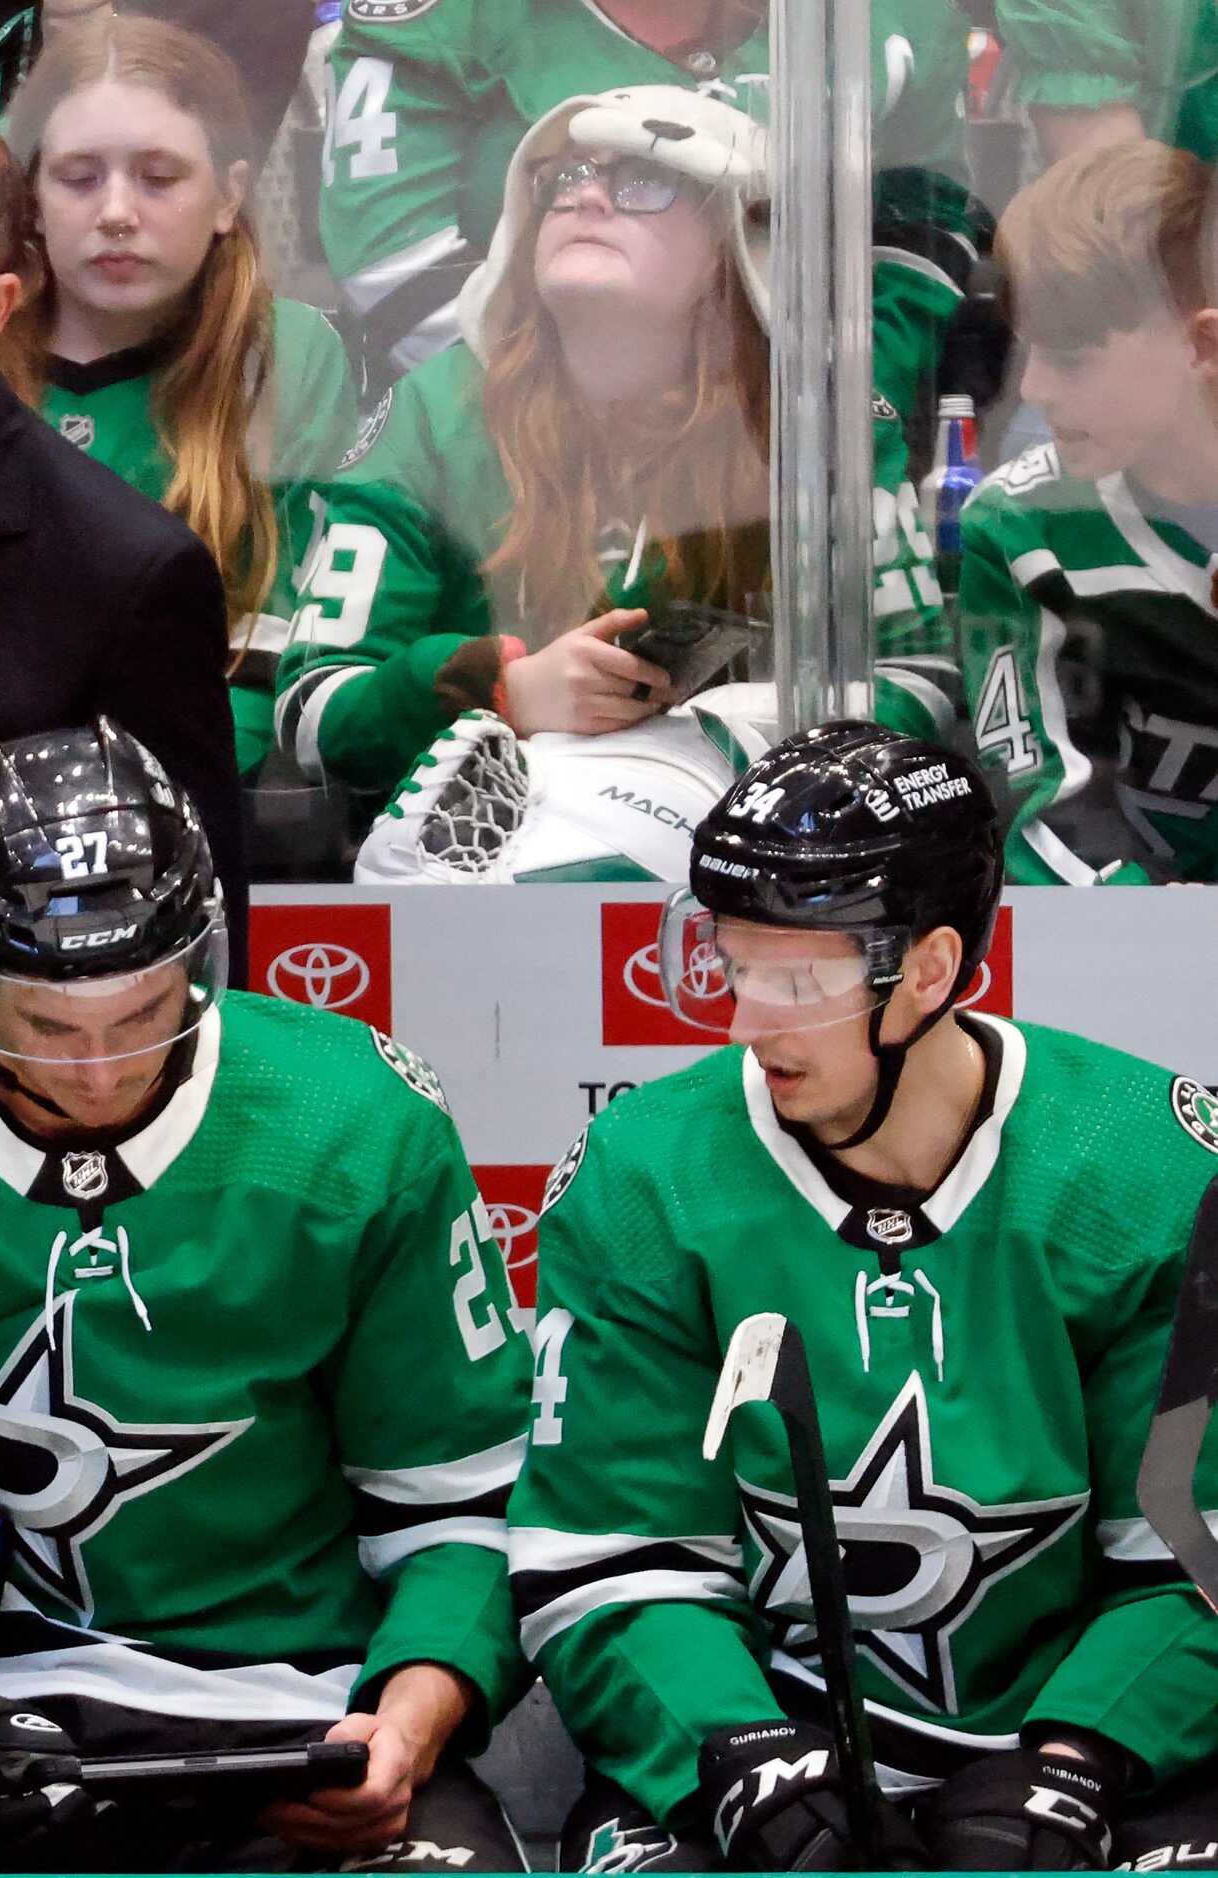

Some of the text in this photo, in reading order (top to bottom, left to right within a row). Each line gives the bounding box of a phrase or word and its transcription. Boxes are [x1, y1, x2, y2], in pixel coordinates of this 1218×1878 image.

[894, 763, 949, 796] ENERGY
[903, 777, 973, 812] TRANSFER
[729, 782, 786, 824] 34
[55, 831, 109, 880] 27
[60, 923, 138, 950] CCM
[730, 1727, 796, 1746] GURIANOV
